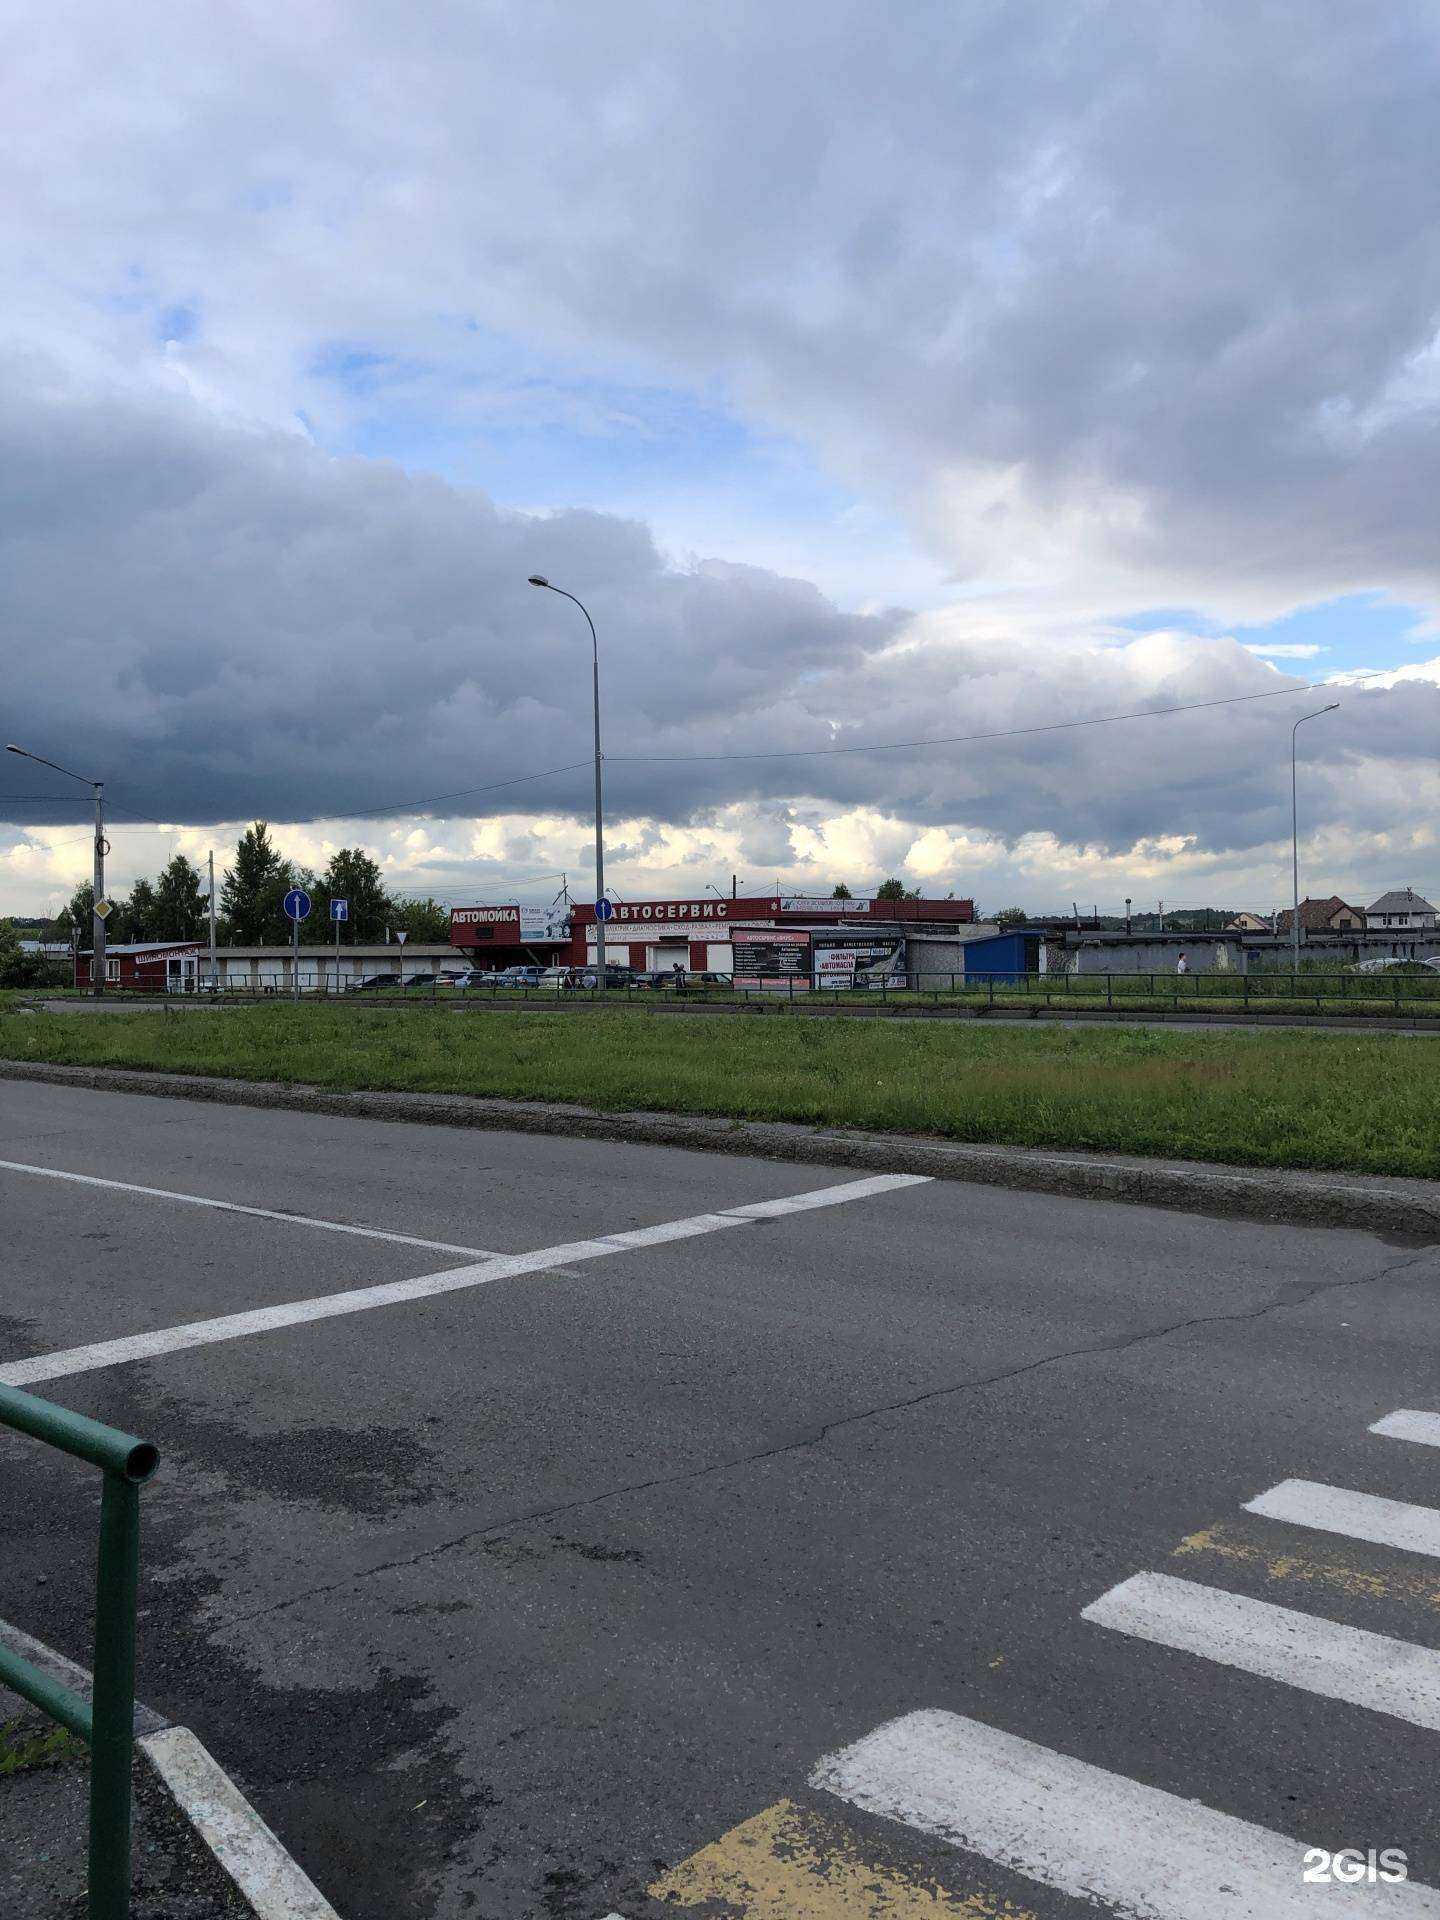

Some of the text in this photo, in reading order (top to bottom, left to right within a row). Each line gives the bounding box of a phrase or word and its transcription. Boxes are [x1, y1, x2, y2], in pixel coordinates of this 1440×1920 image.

[452, 908, 518, 923] АВТОМОЙКА
[611, 903, 727, 919] АВТОСЕРВИС
[138, 948, 198, 962] ШИНОМОНТАЖ
